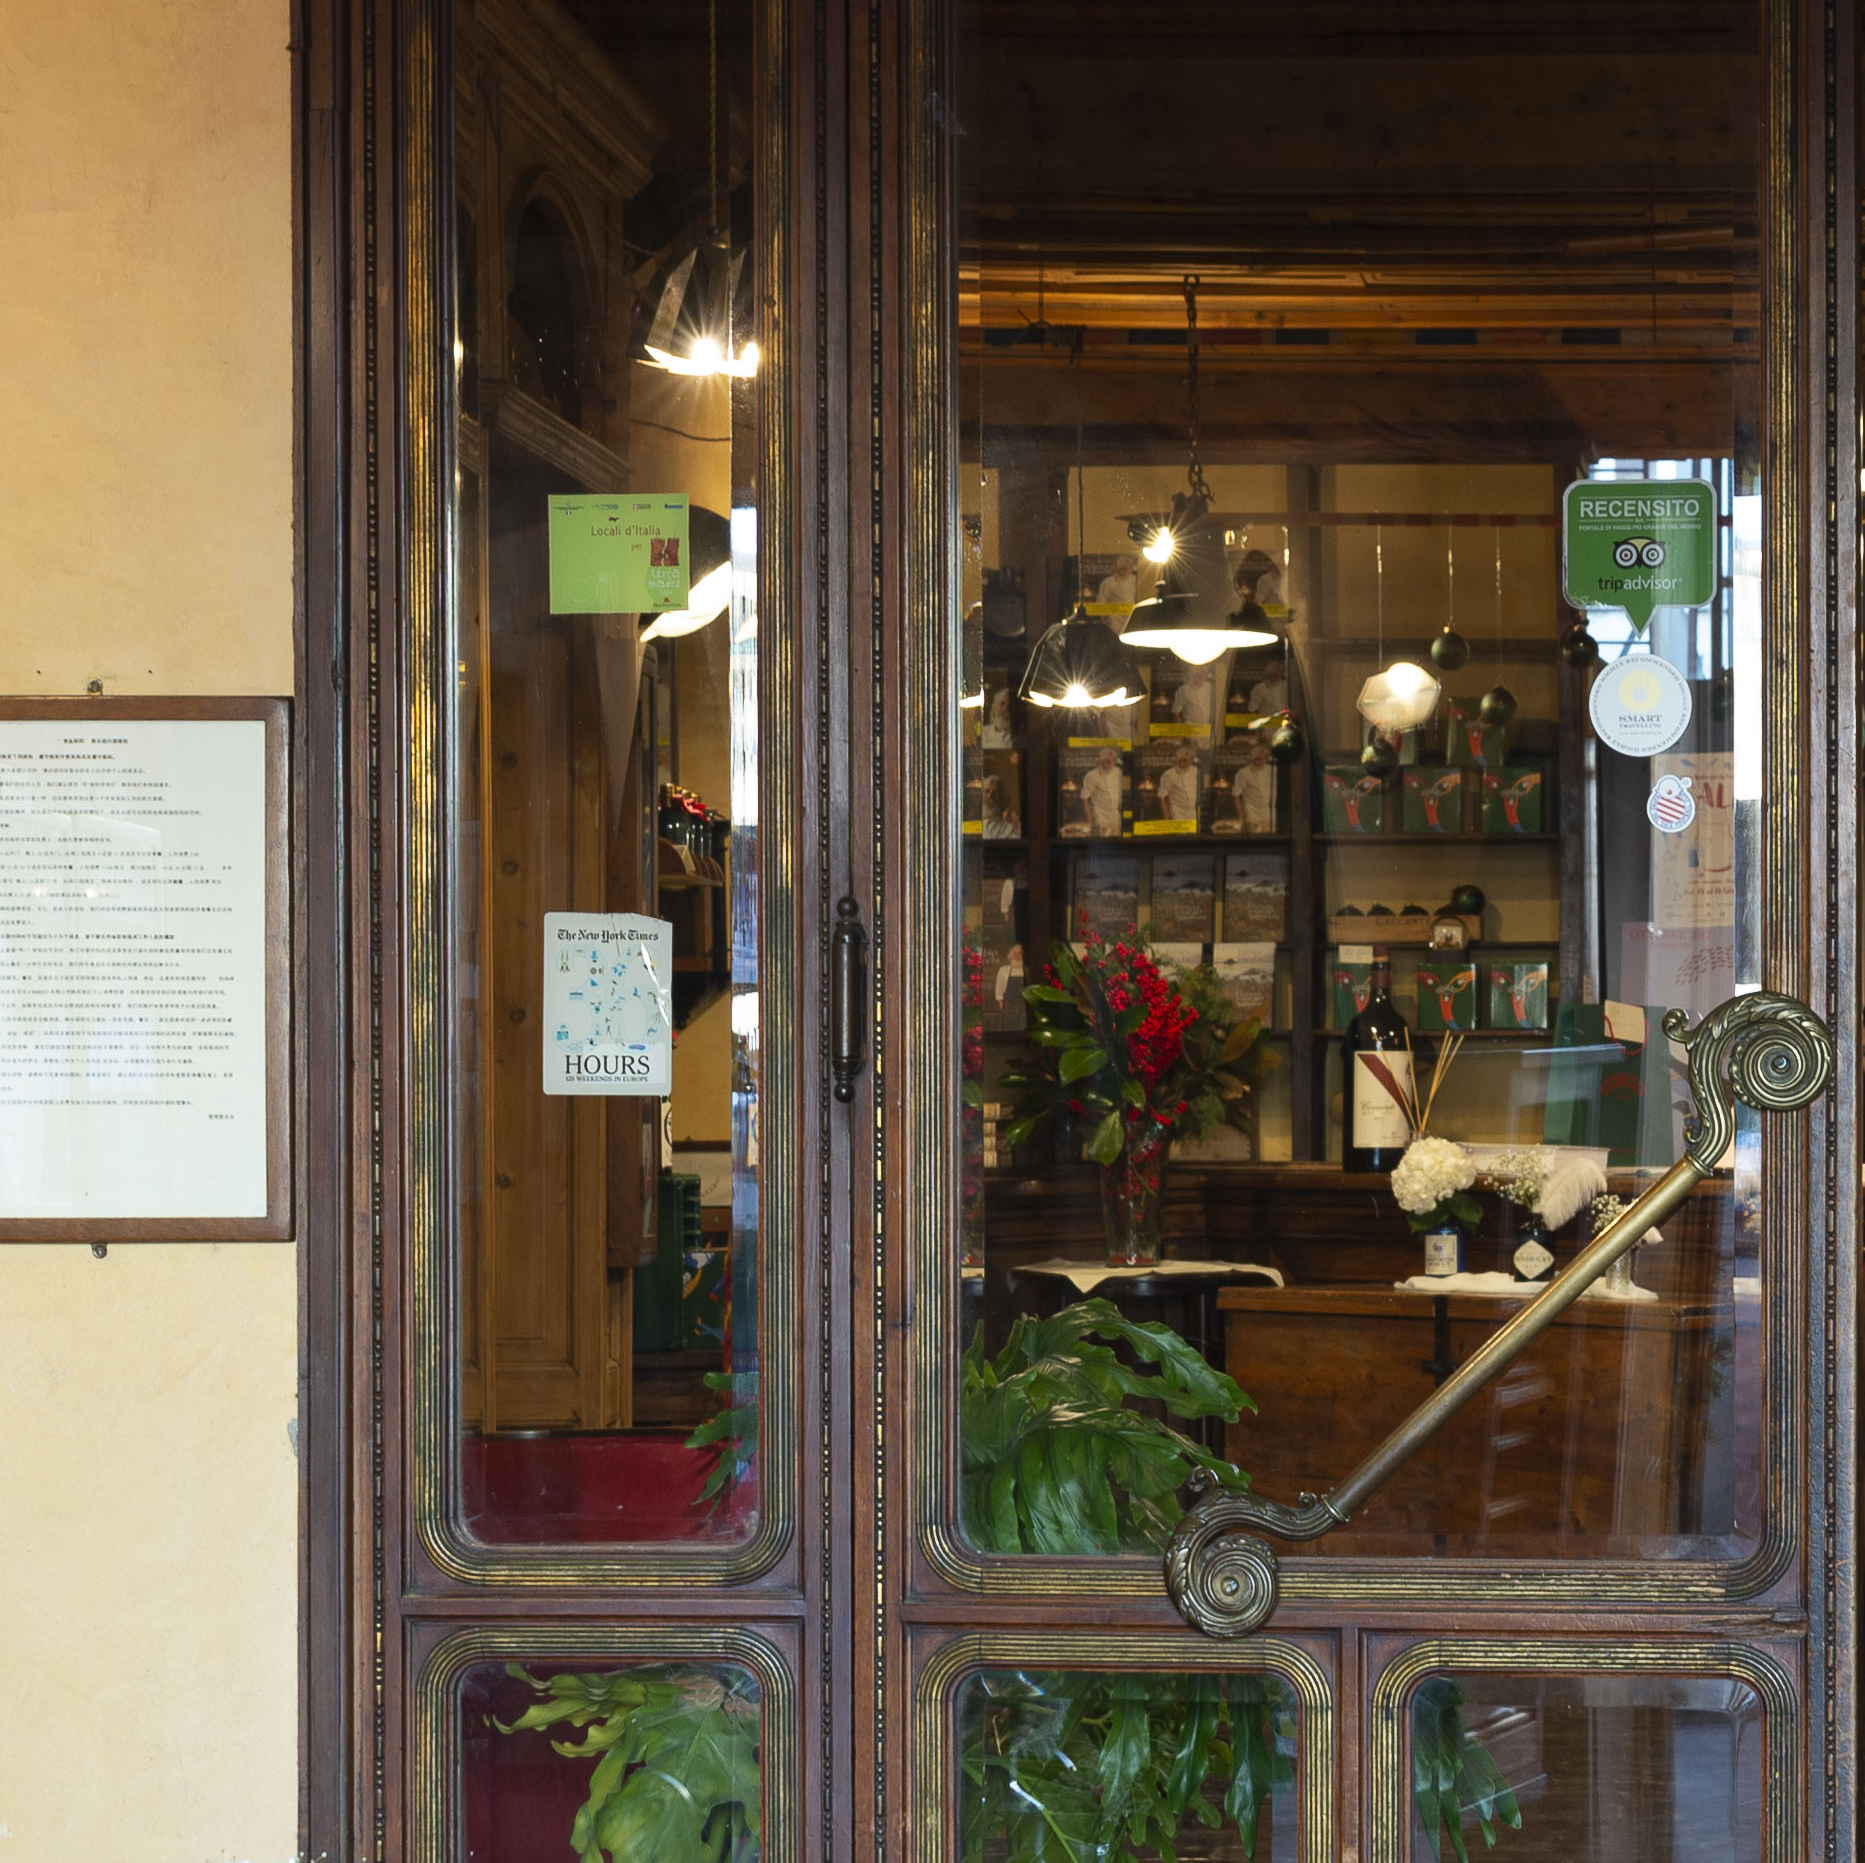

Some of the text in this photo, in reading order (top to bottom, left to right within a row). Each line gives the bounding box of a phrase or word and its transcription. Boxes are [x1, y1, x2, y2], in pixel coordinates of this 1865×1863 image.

[1579, 499, 1700, 518] RECENSITO
[591, 525, 662, 537] Locali d'Italia
[1618, 714, 1663, 723] SMART
[557, 928, 659, 944] The New York Times
[565, 1054, 650, 1075] HOURS
[576, 1075, 613, 1083] WEEKENDS
